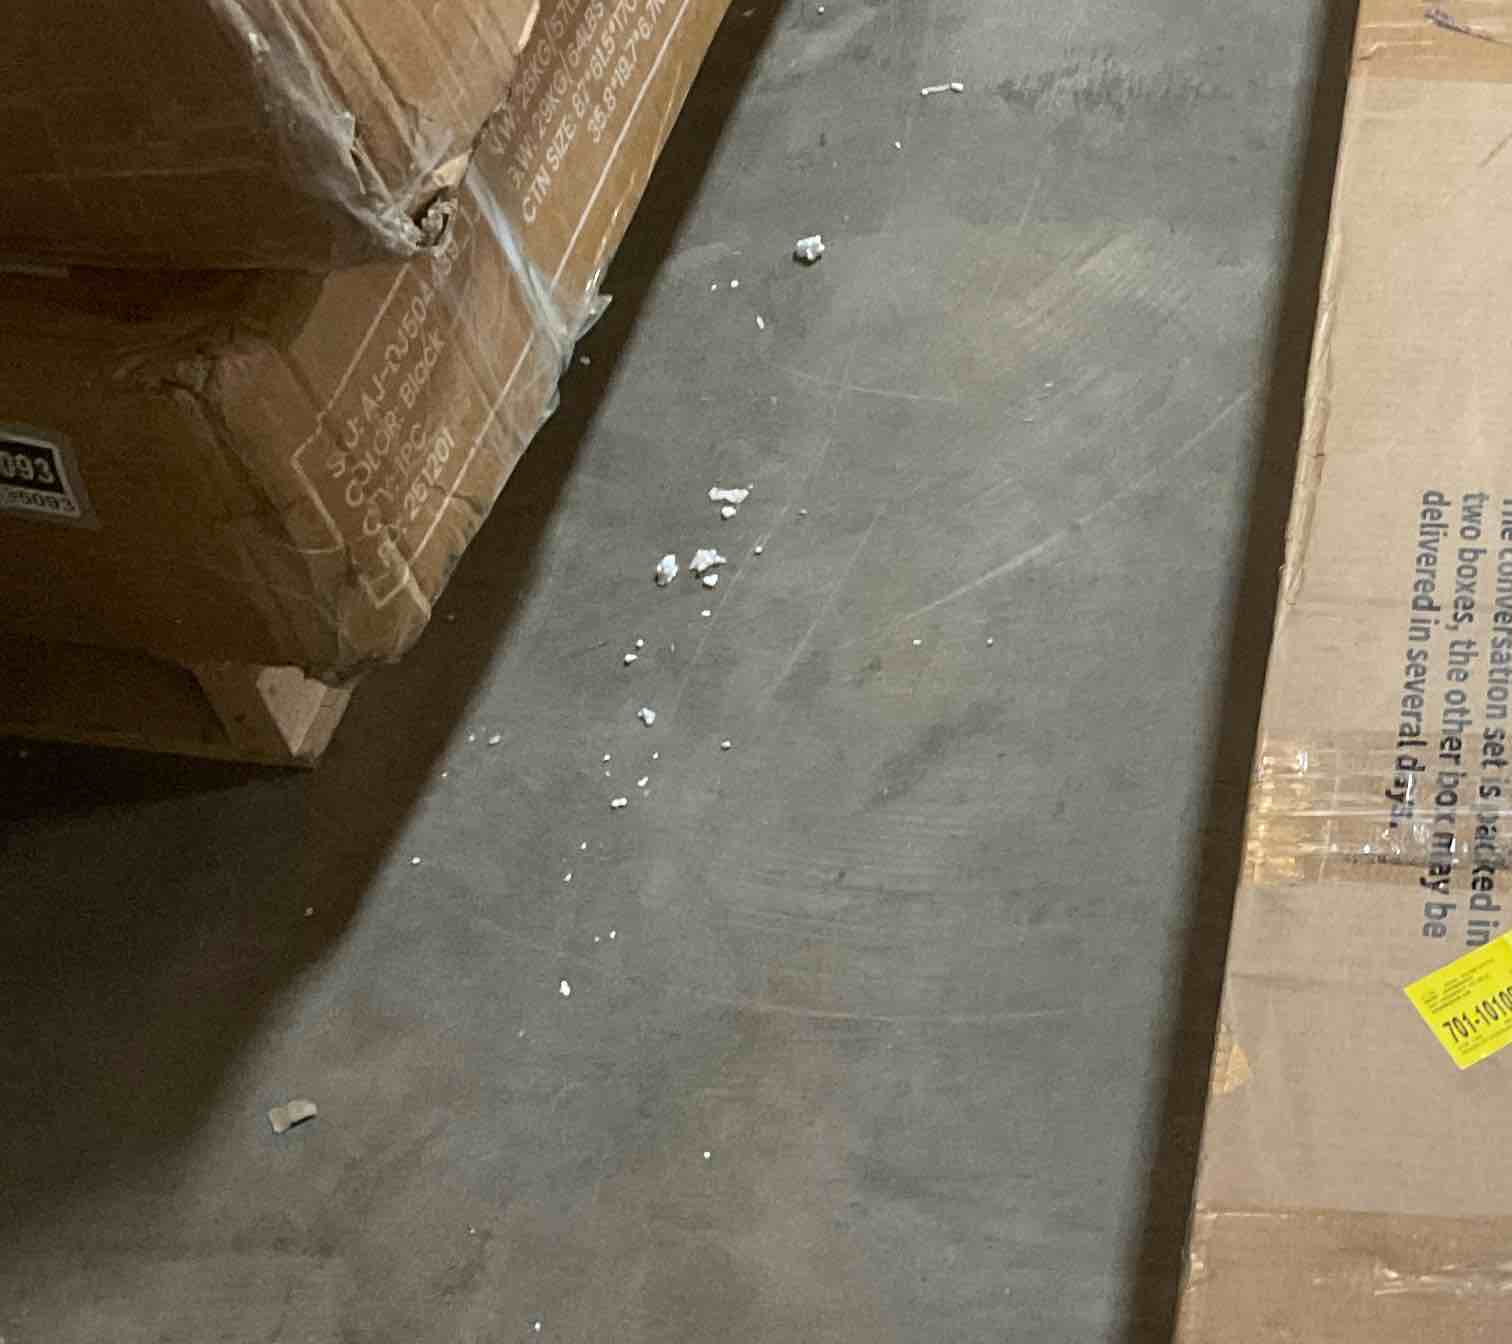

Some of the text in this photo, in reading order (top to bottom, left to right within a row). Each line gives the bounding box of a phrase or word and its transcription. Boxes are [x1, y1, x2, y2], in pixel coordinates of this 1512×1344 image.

[1383, 490, 1450, 829] delivered in several days.
[1419, 492, 1489, 938] two boxes, the other box may be
[1481, 727, 1507, 769] set
[1478, 777, 1508, 800] is
[1465, 920, 1498, 947] in
